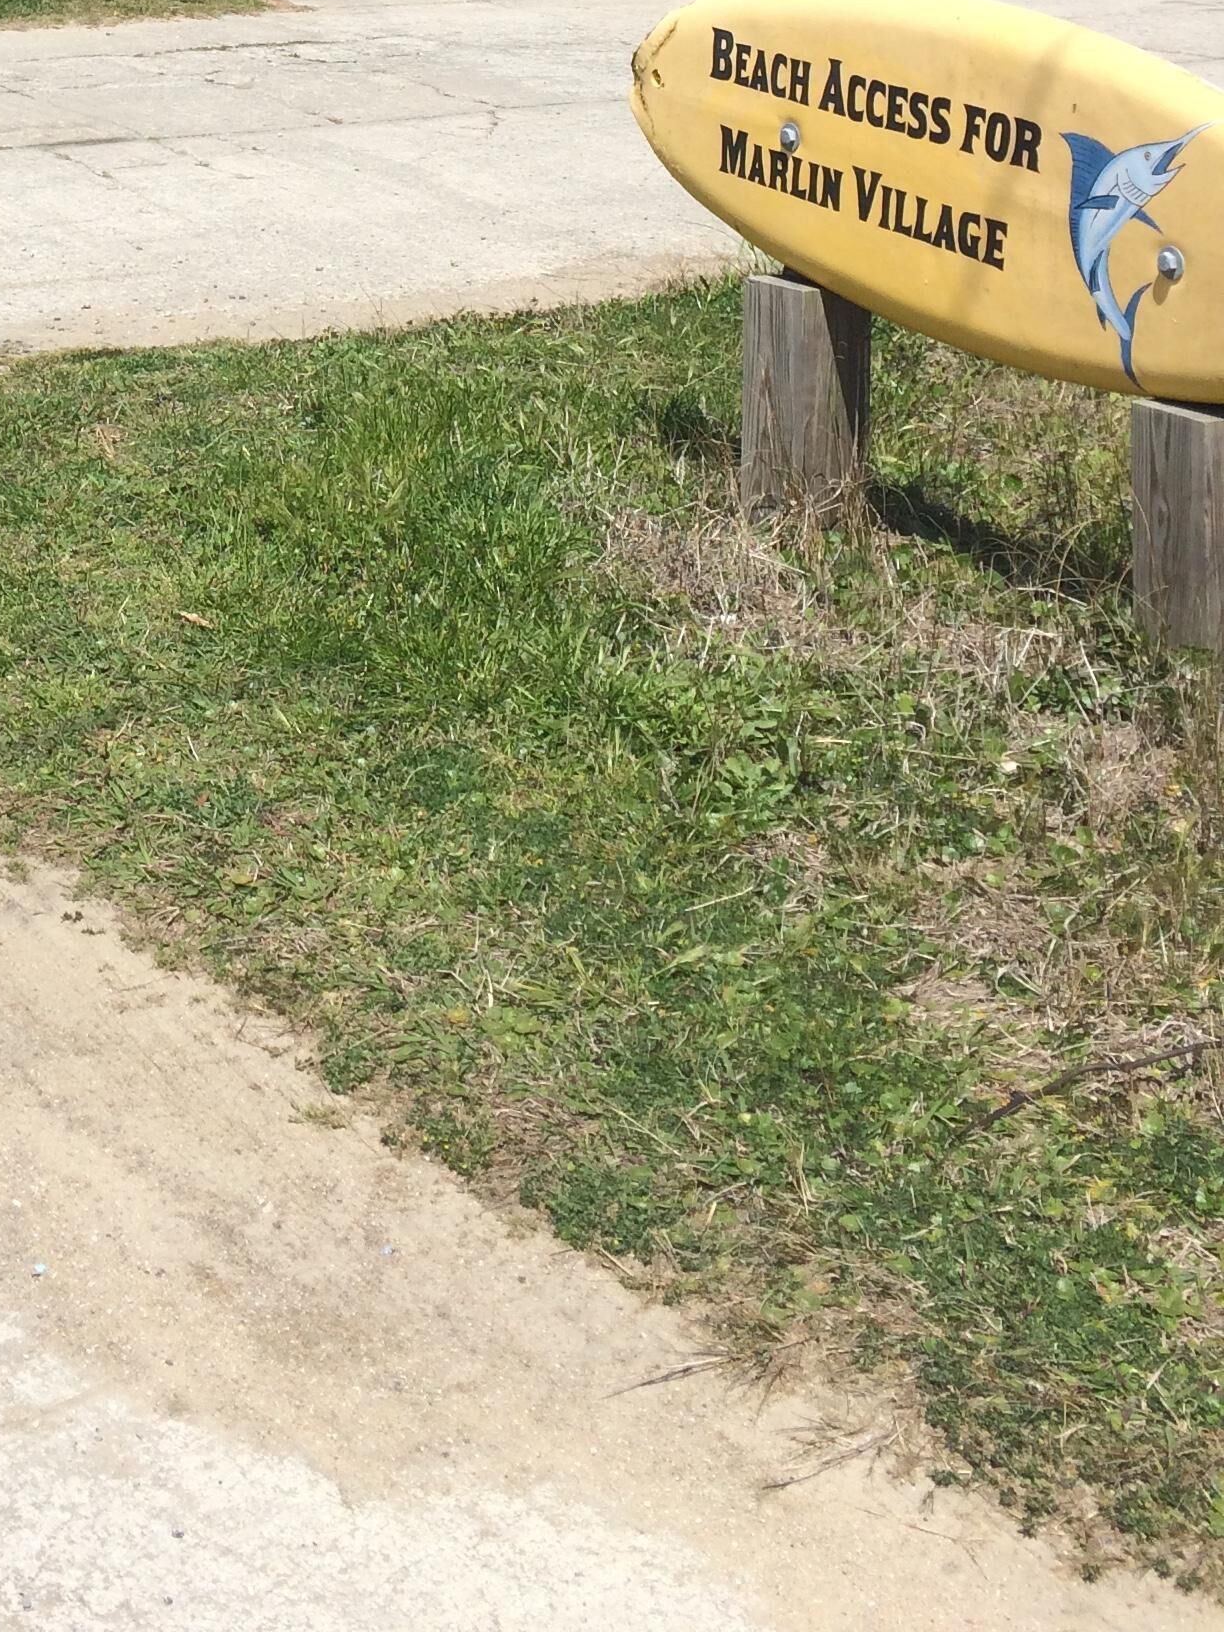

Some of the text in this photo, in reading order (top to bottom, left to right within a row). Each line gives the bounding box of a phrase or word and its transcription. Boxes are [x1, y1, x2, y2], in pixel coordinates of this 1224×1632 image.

[710, 26, 1042, 173] BEACH ACCESS FOR
[719, 124, 1008, 271] MARLIN VILLAGE
